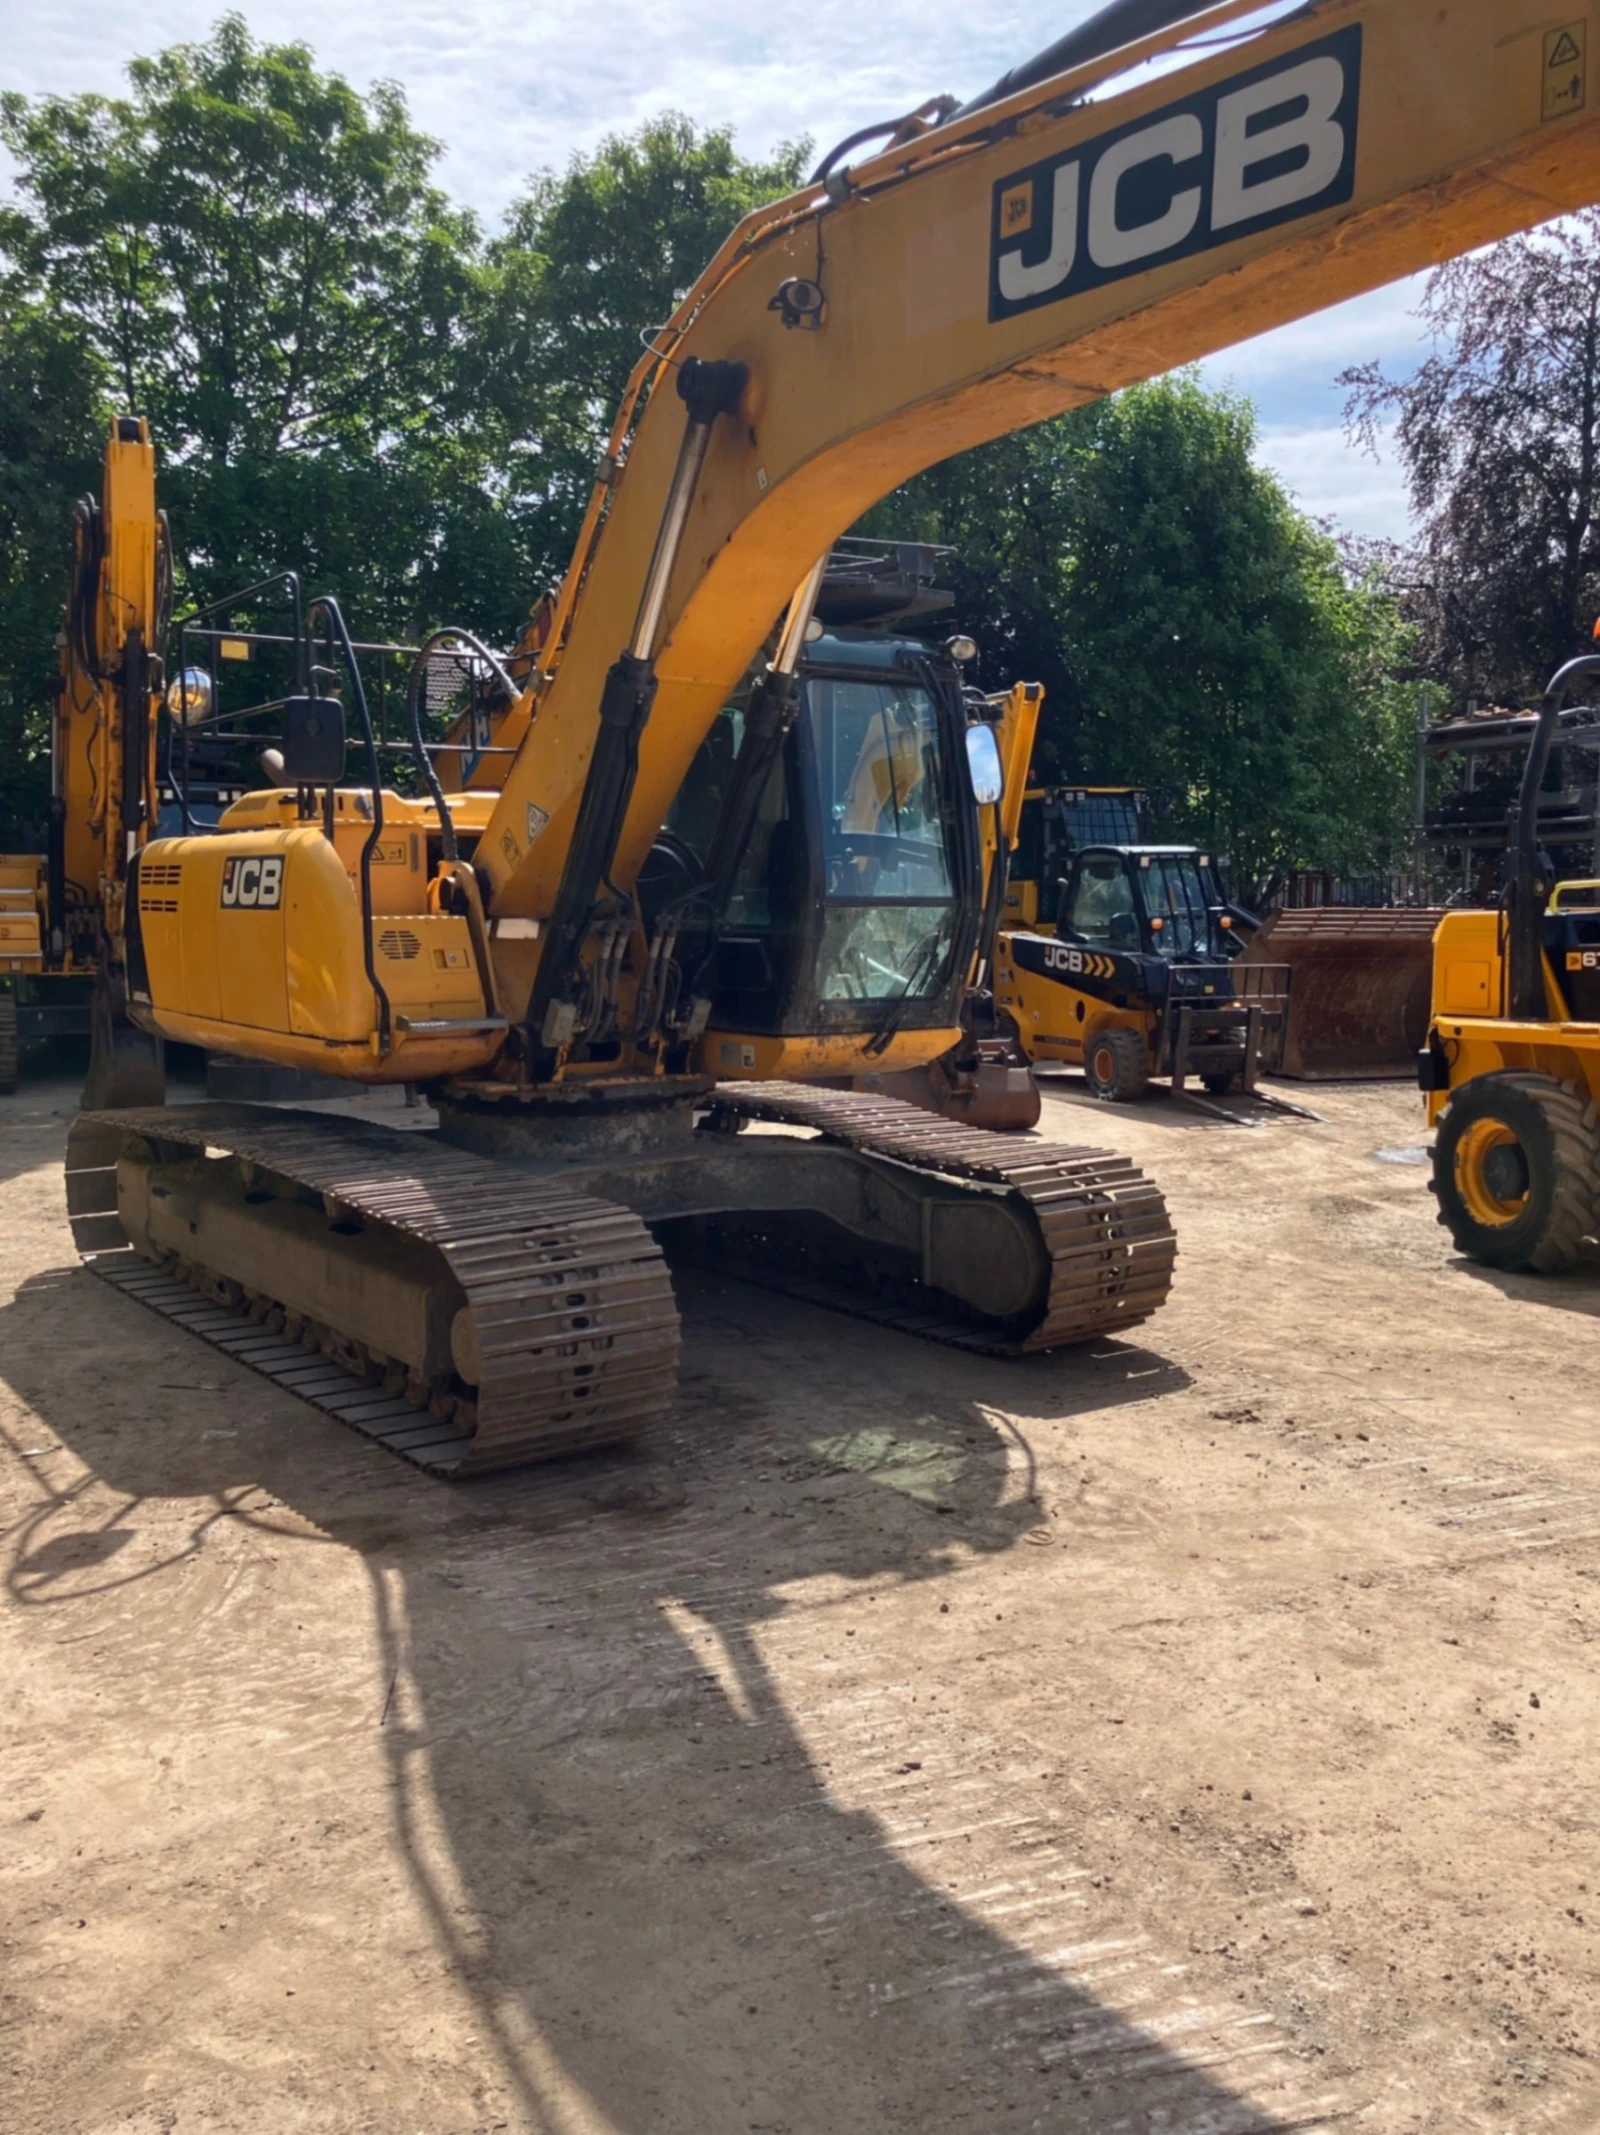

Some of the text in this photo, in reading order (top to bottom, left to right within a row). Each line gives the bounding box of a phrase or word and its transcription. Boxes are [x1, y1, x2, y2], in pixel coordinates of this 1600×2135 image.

[999, 56, 1344, 300] JCB
[222, 859, 282, 905] JCB
[1045, 947, 1082, 972] JCB
